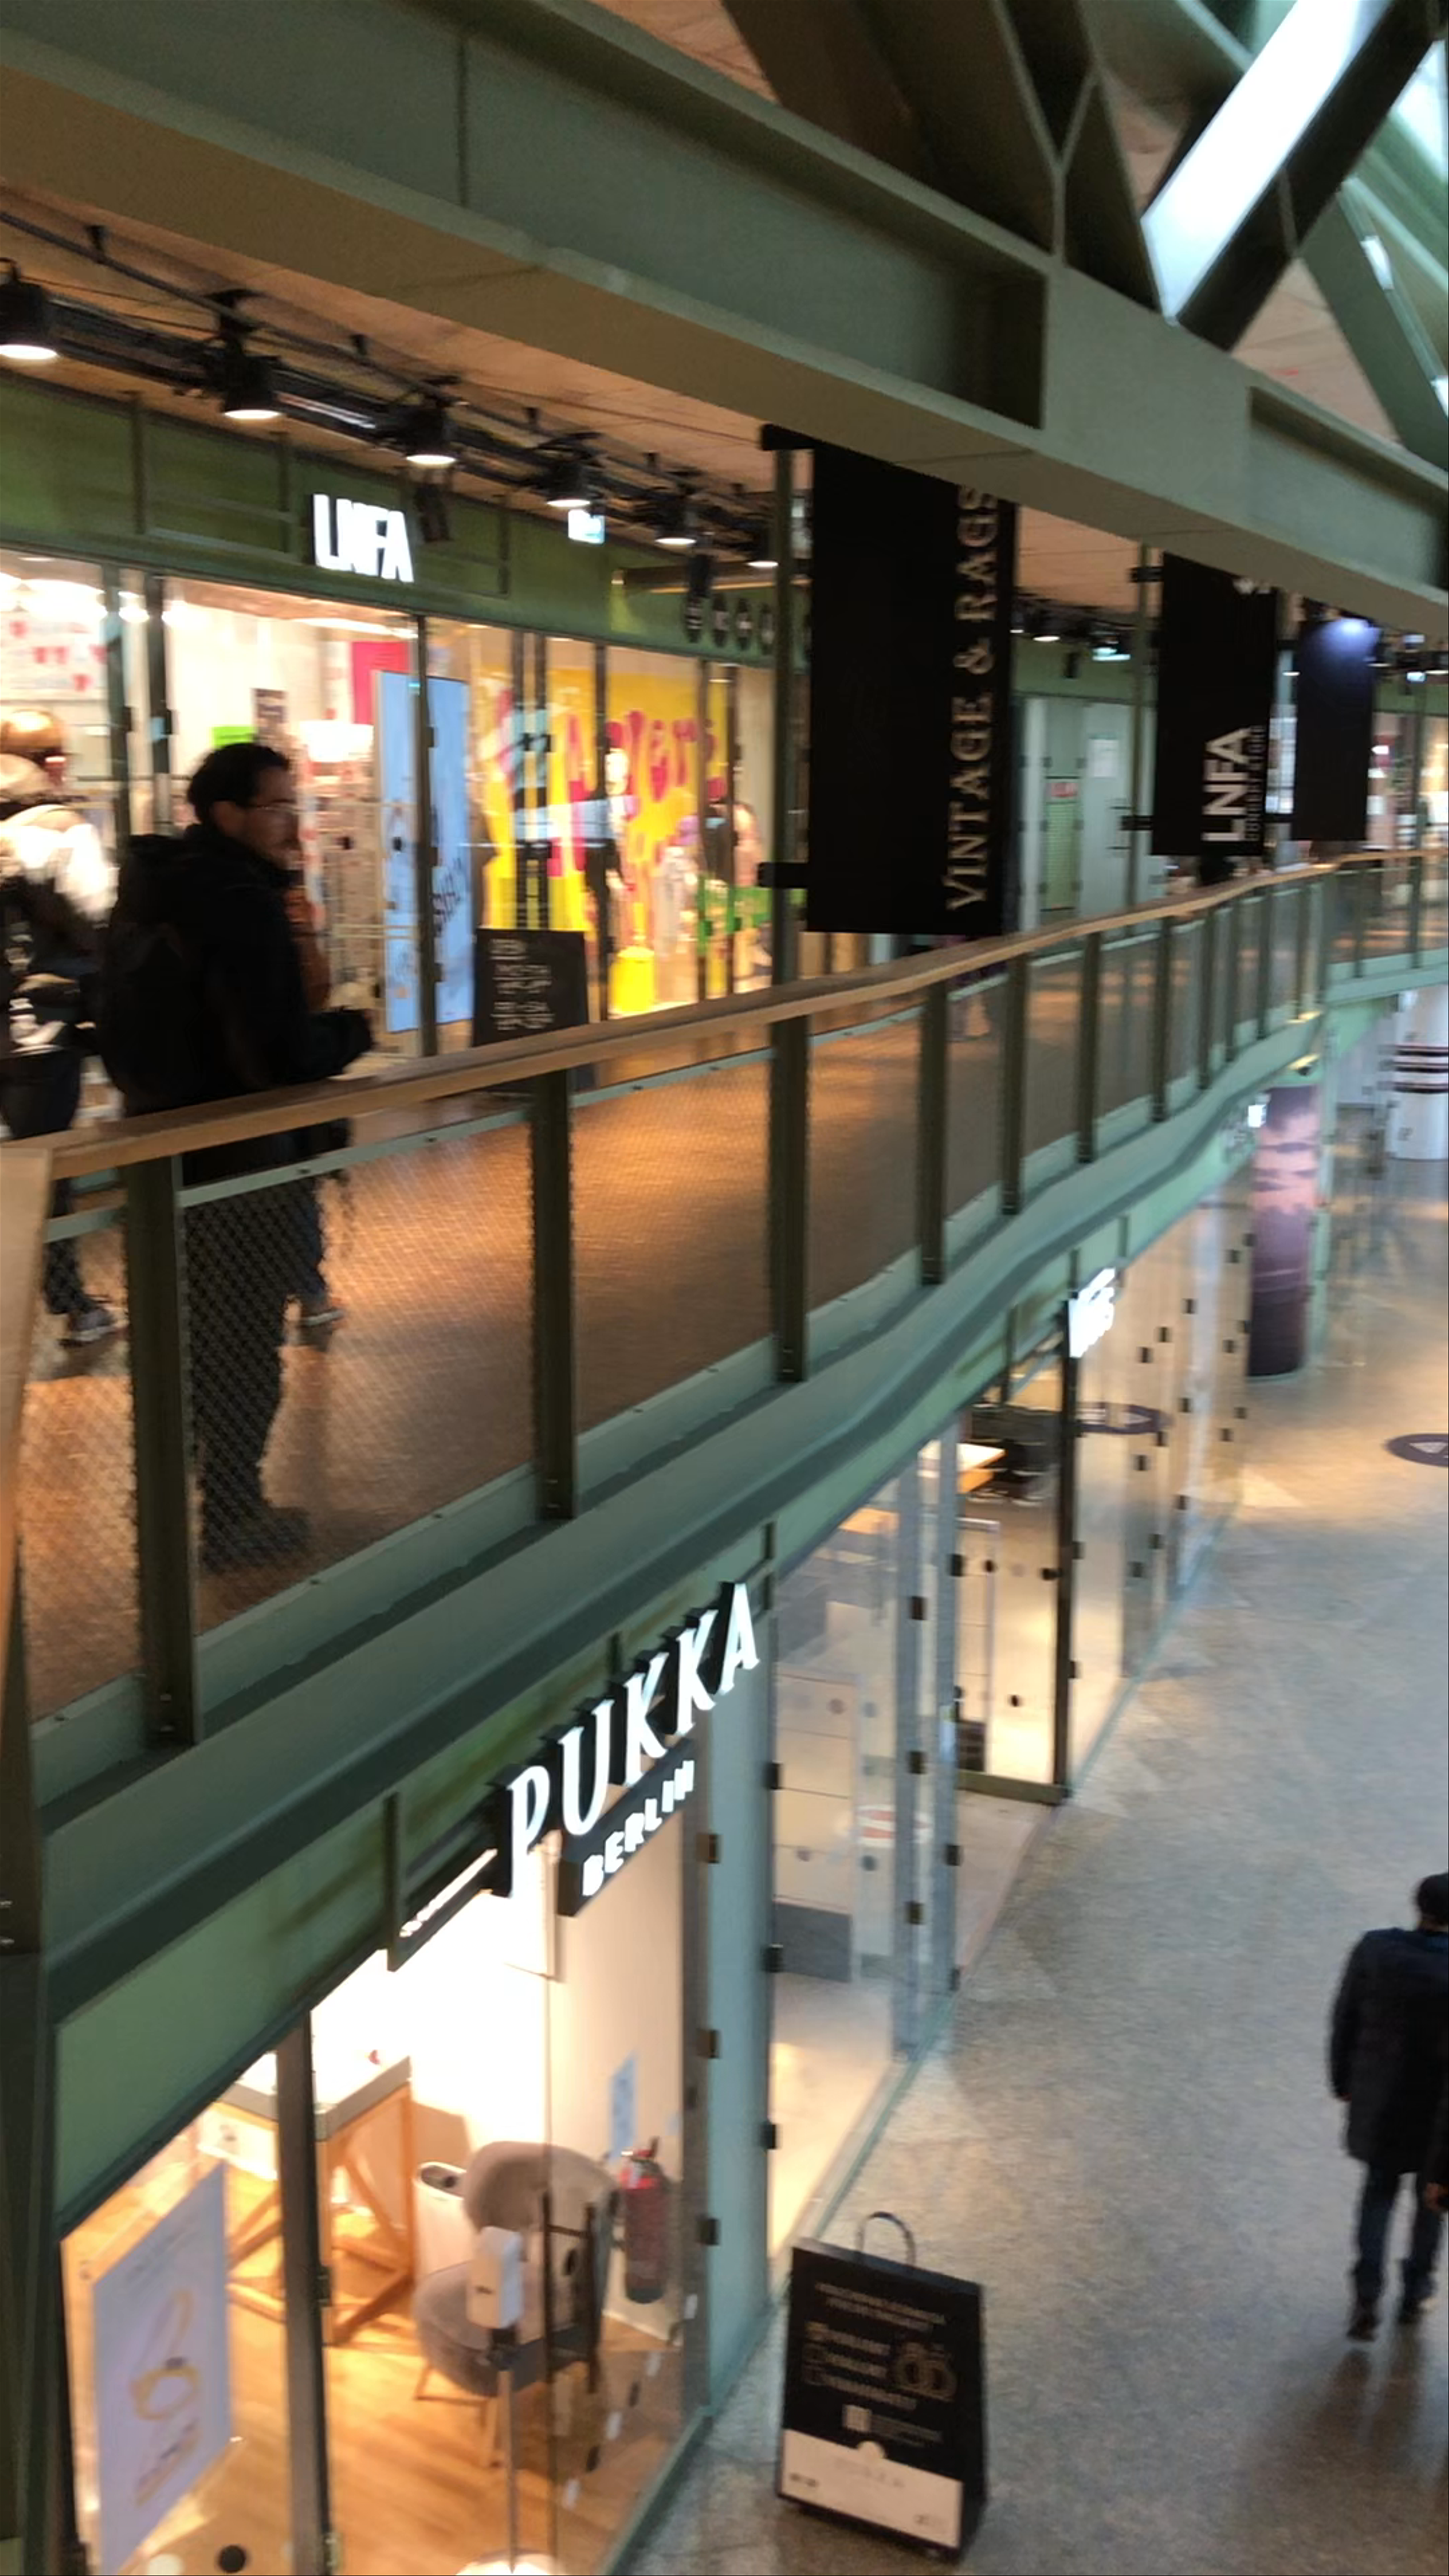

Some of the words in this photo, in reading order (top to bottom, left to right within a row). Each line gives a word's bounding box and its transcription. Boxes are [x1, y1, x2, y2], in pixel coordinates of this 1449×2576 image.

[952, 637, 996, 675] &
[943, 694, 994, 911] VINTAGE
[1201, 727, 1254, 841] LNFA
[506, 1583, 760, 1899] PUKKA
[583, 1760, 694, 1896] BERLIN
